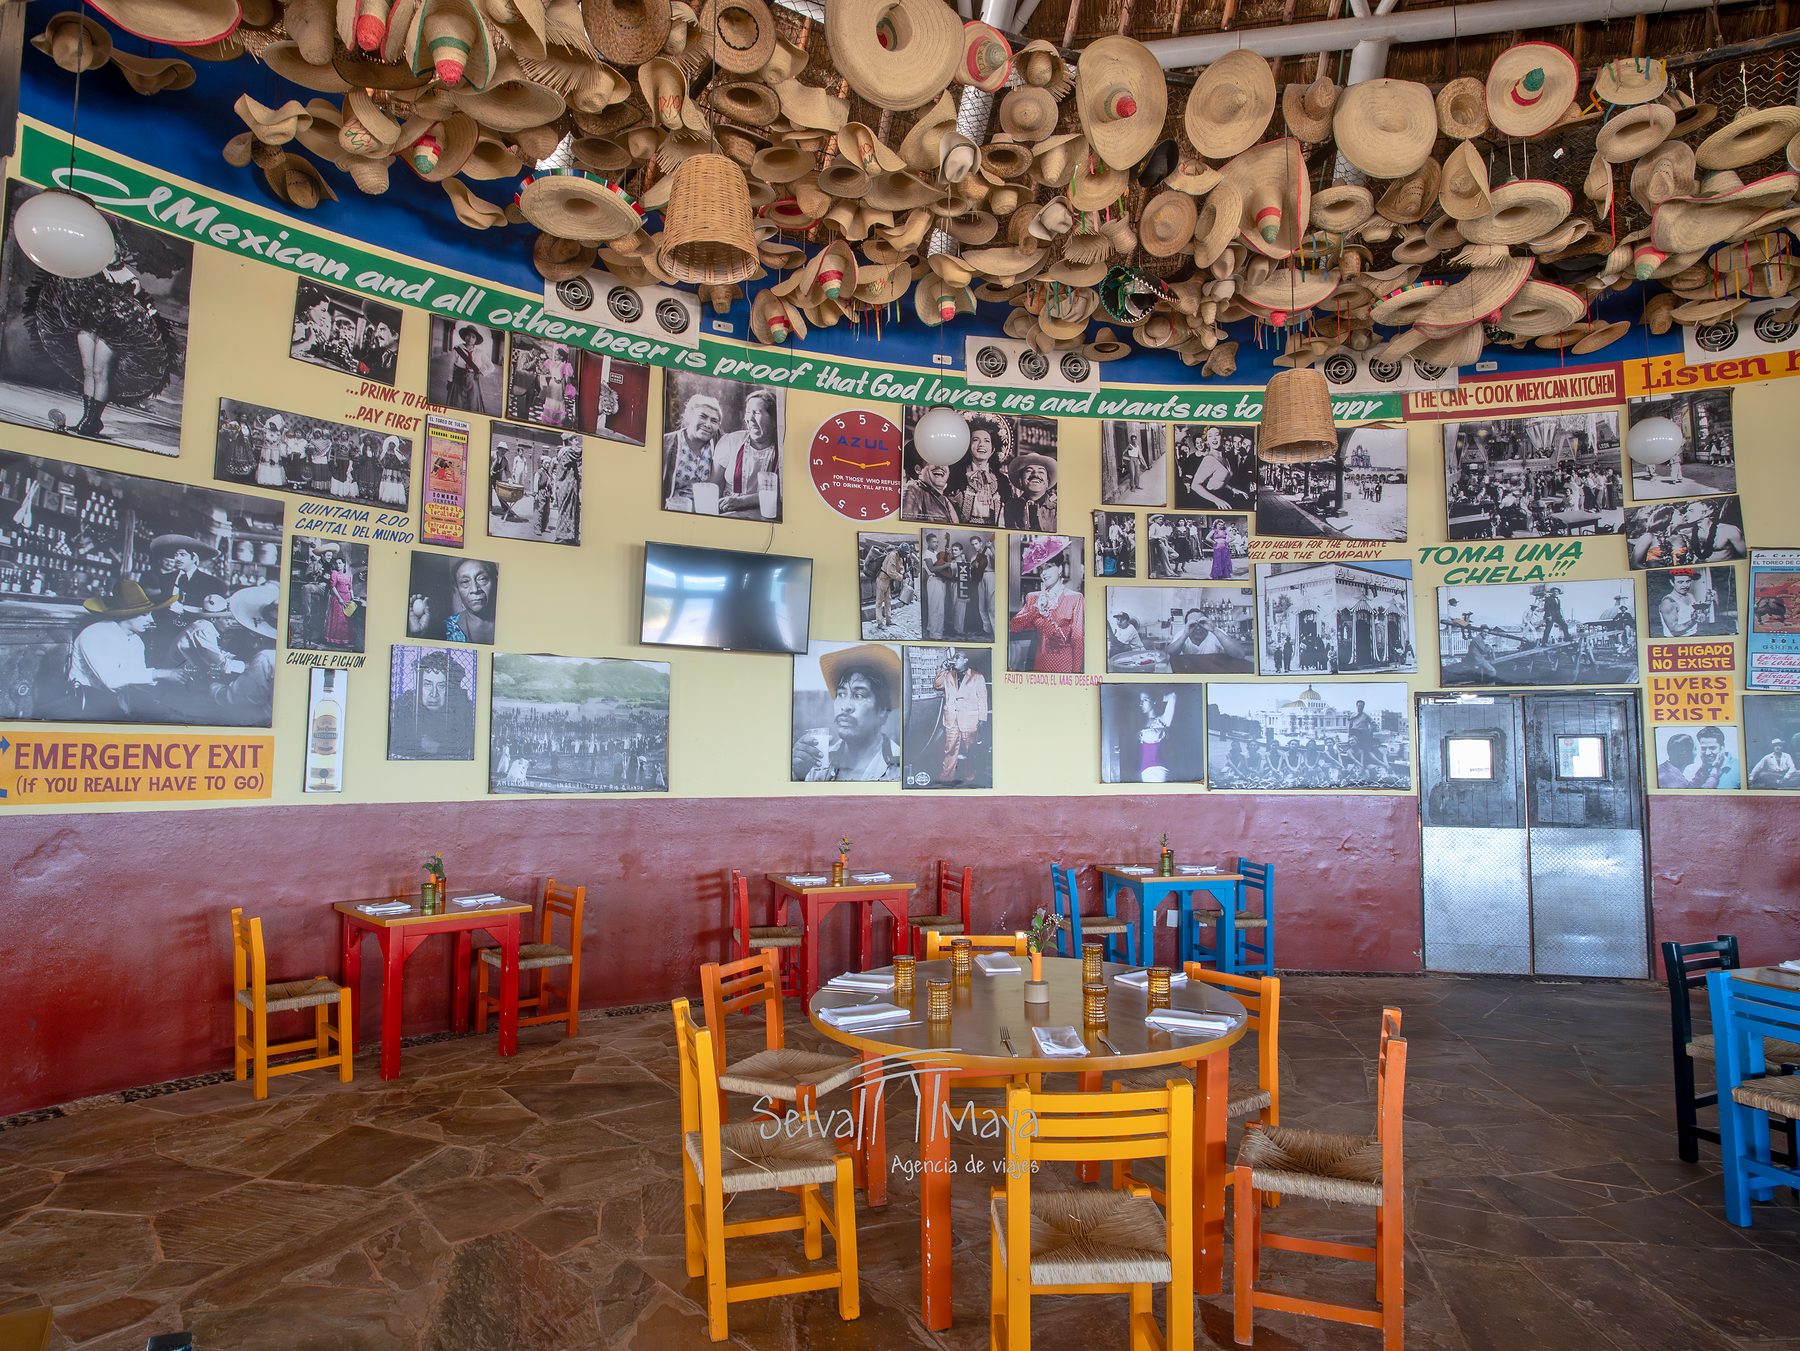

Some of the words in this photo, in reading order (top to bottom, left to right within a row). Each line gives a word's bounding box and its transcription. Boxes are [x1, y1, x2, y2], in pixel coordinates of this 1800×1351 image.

[159, 197, 350, 282] Mexican
[355, 271, 435, 302] and
[431, 286, 487, 317] all
[488, 304, 588, 340] other
[589, 328, 671, 360] beer
[674, 349, 707, 368] is
[713, 357, 814, 384] proof
[816, 361, 869, 394] that
[870, 373, 925, 401] God
[924, 378, 998, 409] loves
[1002, 393, 1036, 412] us
[1040, 392, 1098, 414] and
[1097, 394, 1191, 419] wants
[1193, 403, 1228, 419] us
[1233, 394, 1263, 419] to
[1331, 400, 1383, 420] ppy
[1642, 355, 1772, 390] Listen
[1414, 391, 1437, 408] THE
[1440, 383, 1513, 407] CAN-COOK
[1515, 379, 1569, 402] MEXICAN
[1569, 373, 1615, 396] KITCHEN
[400, 391, 416, 407] TO
[384, 412, 422, 432] FIRST
[835, 418, 846, 429] 5
[859, 414, 867, 425] 5
[881, 422, 890, 433] 5
[818, 433, 830, 444] 5
[836, 435, 889, 451] AZUL
[813, 458, 823, 466] 5
[845, 475, 864, 483] THOSE
[432, 492, 458, 501] SOMBRA
[298, 502, 370, 523] QUINTANA
[375, 513, 410, 528] ROO
[294, 518, 348, 536] CAPITAL
[351, 525, 370, 539] DEL
[371, 528, 415, 544] MUNDO
[1261, 540, 1272, 549] TO
[1272, 540, 1303, 549] HEAVEN
[1305, 540, 1323, 549] FOR
[1324, 539, 1342, 549] THE
[1346, 540, 1387, 548] CLIMATE
[1268, 551, 1289, 560] FOR
[1293, 550, 1314, 560] THE
[1318, 550, 1382, 560] COMPANY
[1418, 545, 1505, 565] TOMA
[1514, 541, 1584, 563] UNA
[1443, 559, 1576, 585] CHELA!!!
[960, 565, 968, 598] XELL
[1652, 647, 1673, 657] EL
[1678, 644, 1733, 656] HIGADO
[286, 651, 329, 667] CHUPALE
[330, 655, 367, 668] PICHON
[1652, 659, 1673, 670] NO
[1677, 657, 1732, 669] EXISTE
[1004, 673, 1023, 684] FRUTO
[1653, 676, 1727, 691] LIVERS
[1653, 693, 1680, 706] DO
[1687, 692, 1730, 705] NOT
[1654, 707, 1730, 721] EXIST.
[14, 743, 201, 770] EMERGENCY
[208, 744, 264, 769] EXIT
[44, 777, 77, 793] YOU
[84, 776, 142, 793] REALLY
[149, 775, 197, 792] HAVE
[204, 775, 226, 791] TO
[234, 772, 265, 793] GO)
